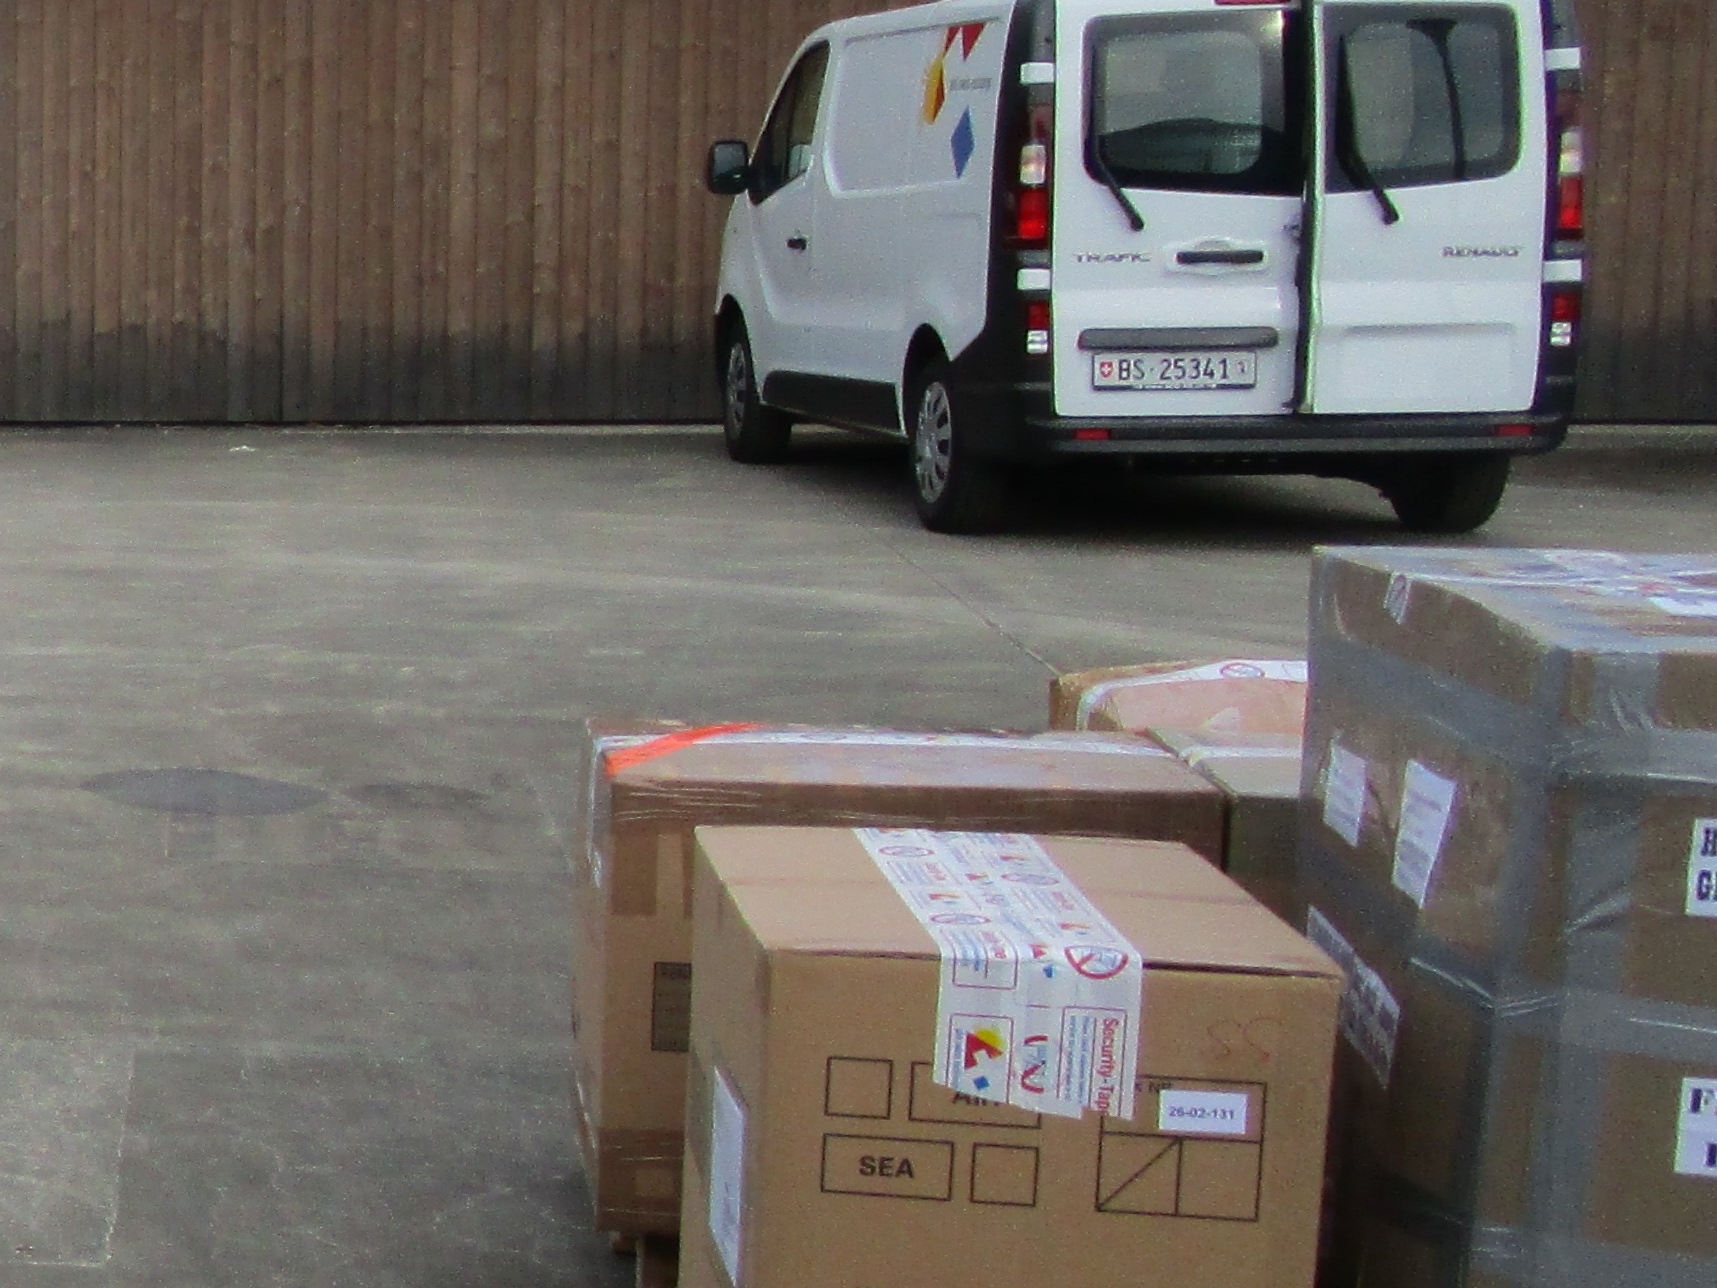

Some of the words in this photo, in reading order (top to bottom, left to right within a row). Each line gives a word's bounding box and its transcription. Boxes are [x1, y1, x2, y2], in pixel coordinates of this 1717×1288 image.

[1073, 252, 1152, 264] TRAFIC
[1442, 245, 1523, 258] RENAULT
[1118, 359, 1145, 380] BS
[1159, 357, 1230, 380] 25341
[1168, 1105, 1236, 1121] 26-02-131
[858, 1155, 915, 1180] SEA
